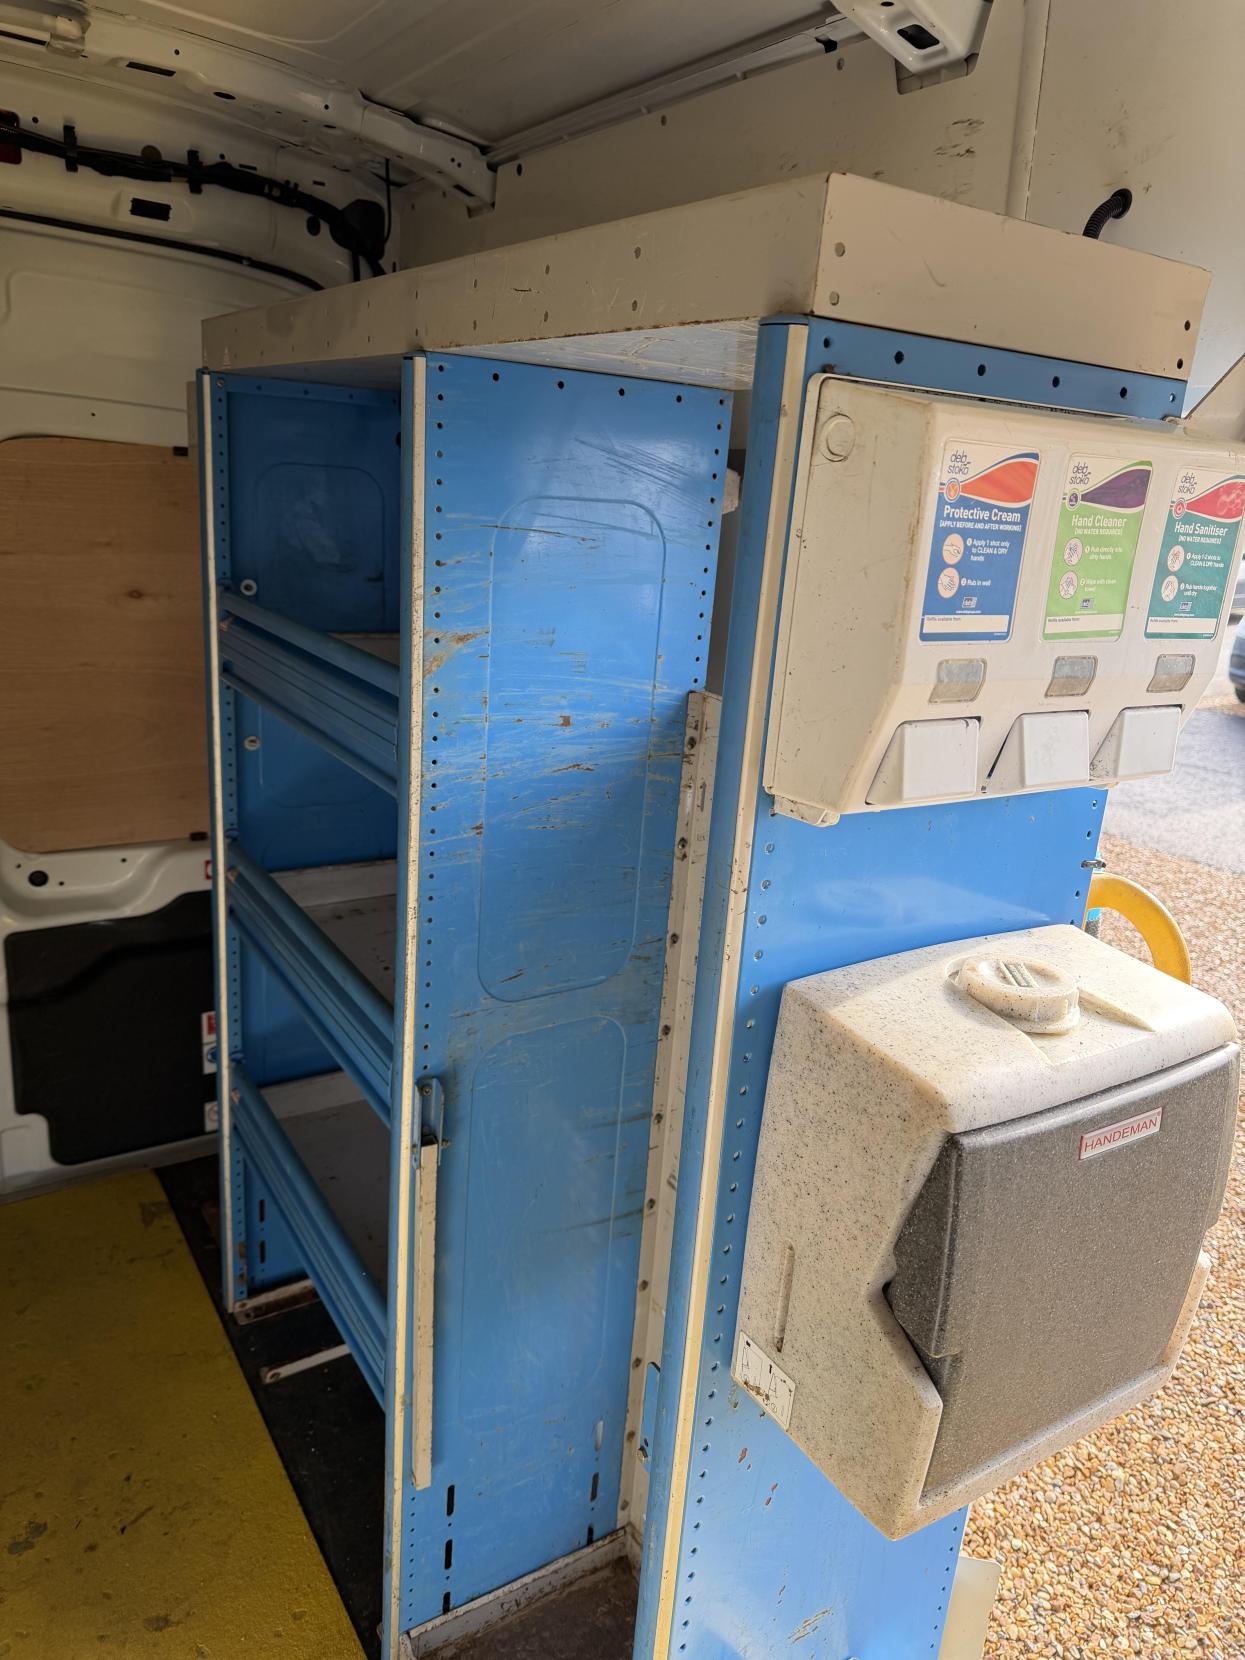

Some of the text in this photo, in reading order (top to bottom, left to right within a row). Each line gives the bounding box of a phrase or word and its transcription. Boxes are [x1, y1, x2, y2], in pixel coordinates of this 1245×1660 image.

[950, 449, 968, 463] deb
[947, 463, 969, 475] stoko
[1072, 462, 1089, 475] deb
[1180, 472, 1195, 484] deb
[943, 505, 1021, 522] Protective Cream
[1071, 514, 1127, 527] Hand Cleaner
[1174, 521, 1229, 536] Hand Sanitiser
[973, 539, 986, 547] Apply
[1084, 1116, 1158, 1152] HANDEMAN
